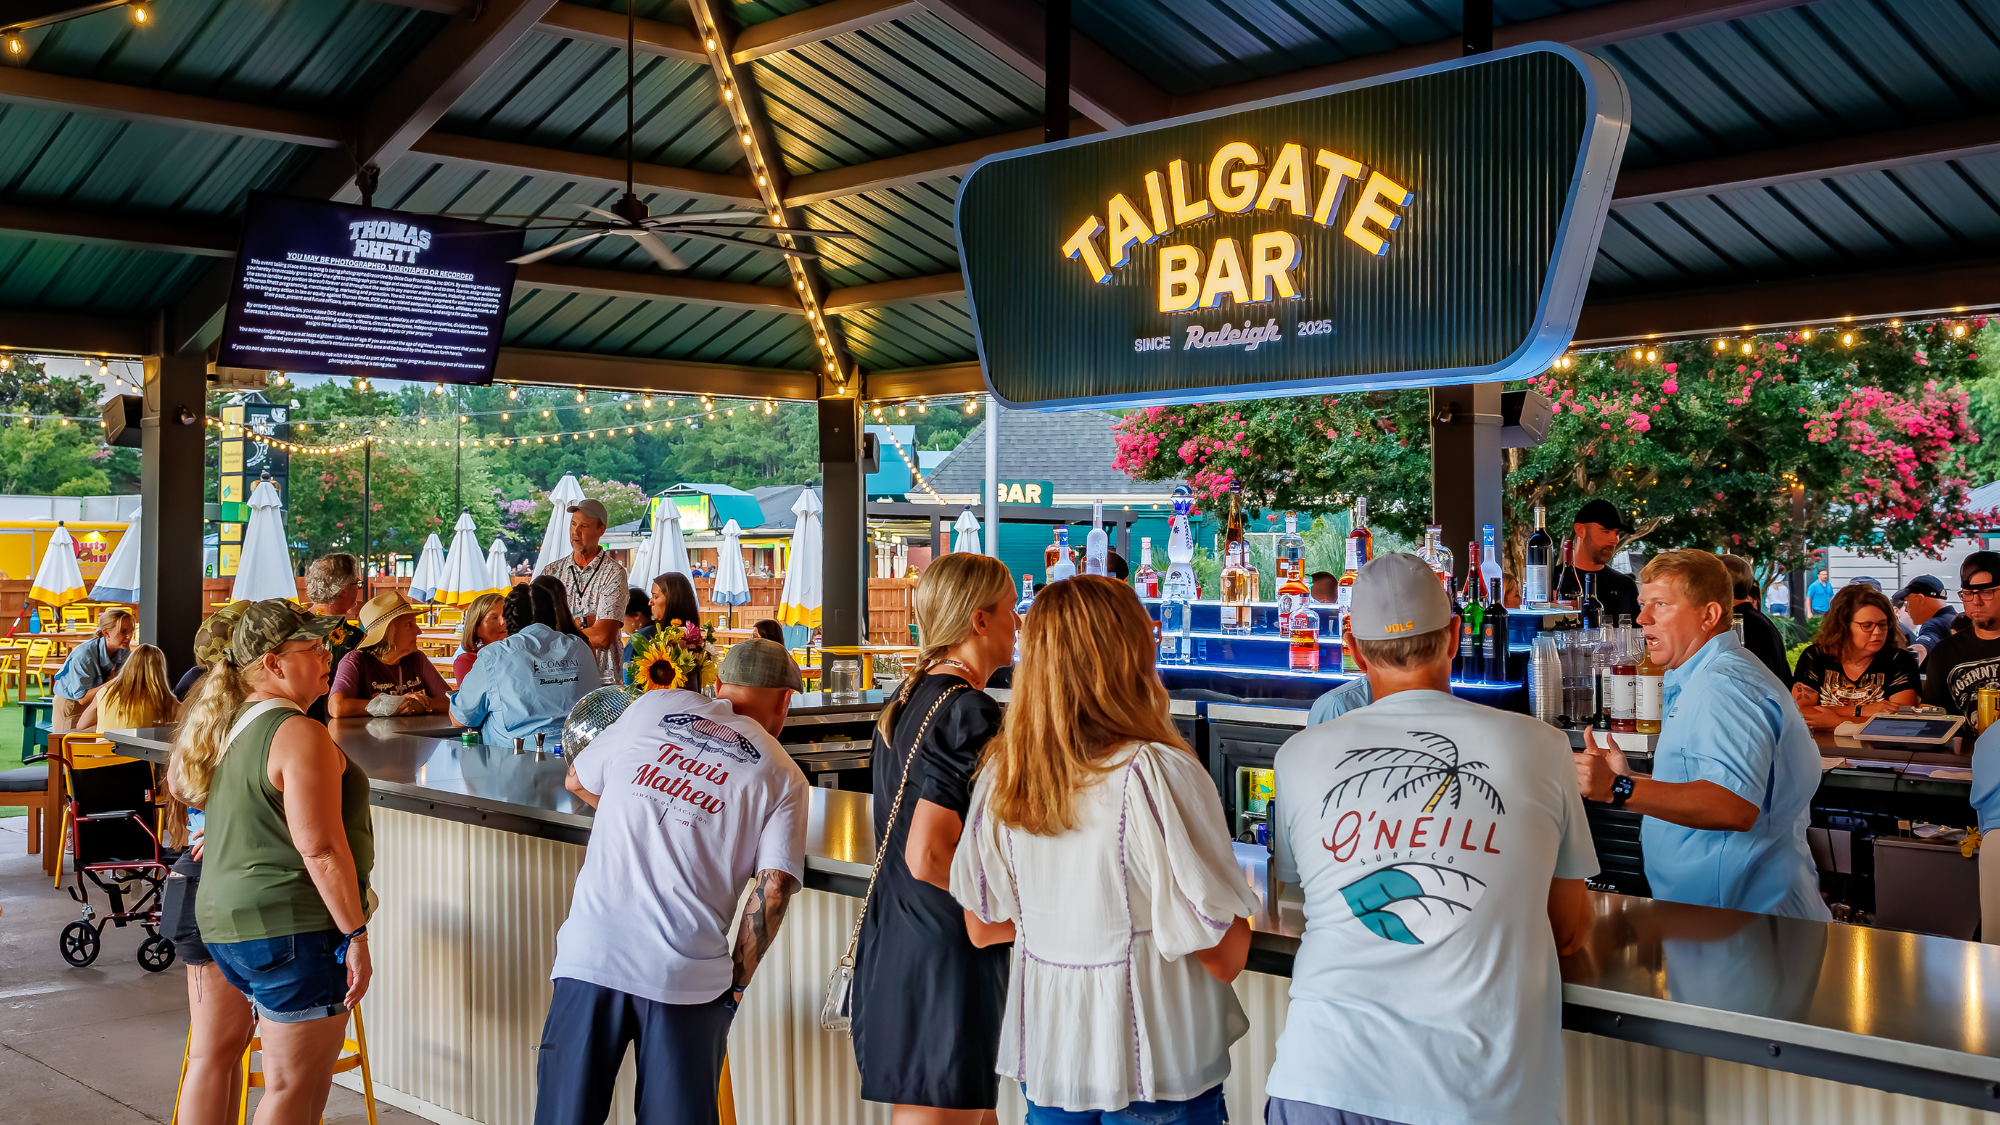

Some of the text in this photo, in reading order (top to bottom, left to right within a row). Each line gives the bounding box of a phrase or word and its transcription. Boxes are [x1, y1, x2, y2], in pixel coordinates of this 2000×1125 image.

[1061, 141, 1415, 284] TAILGATE
[349, 220, 431, 249] THOMAS
[353, 240, 420, 264] RHETT
[388, 264, 429, 275] VIDEOTAPED
[440, 270, 474, 280] RECORDED
[1158, 230, 1303, 314] BAR
[1134, 318, 1332, 352] SINCE Raleigh 2025
[998, 483, 1042, 504] BAR
[1384, 621, 1414, 633] VOLS
[540, 659, 581, 669] COASTAL
[540, 676, 579, 685] Backyard
[1953, 664, 1999, 696] JOHNNY
[657, 743, 729, 786] Travis
[631, 764, 725, 815] Mathew
[673, 806, 708, 824] VACATION
[1322, 810, 1501, 862] O'NEILL
[1360, 851, 1454, 866] SURF CO
